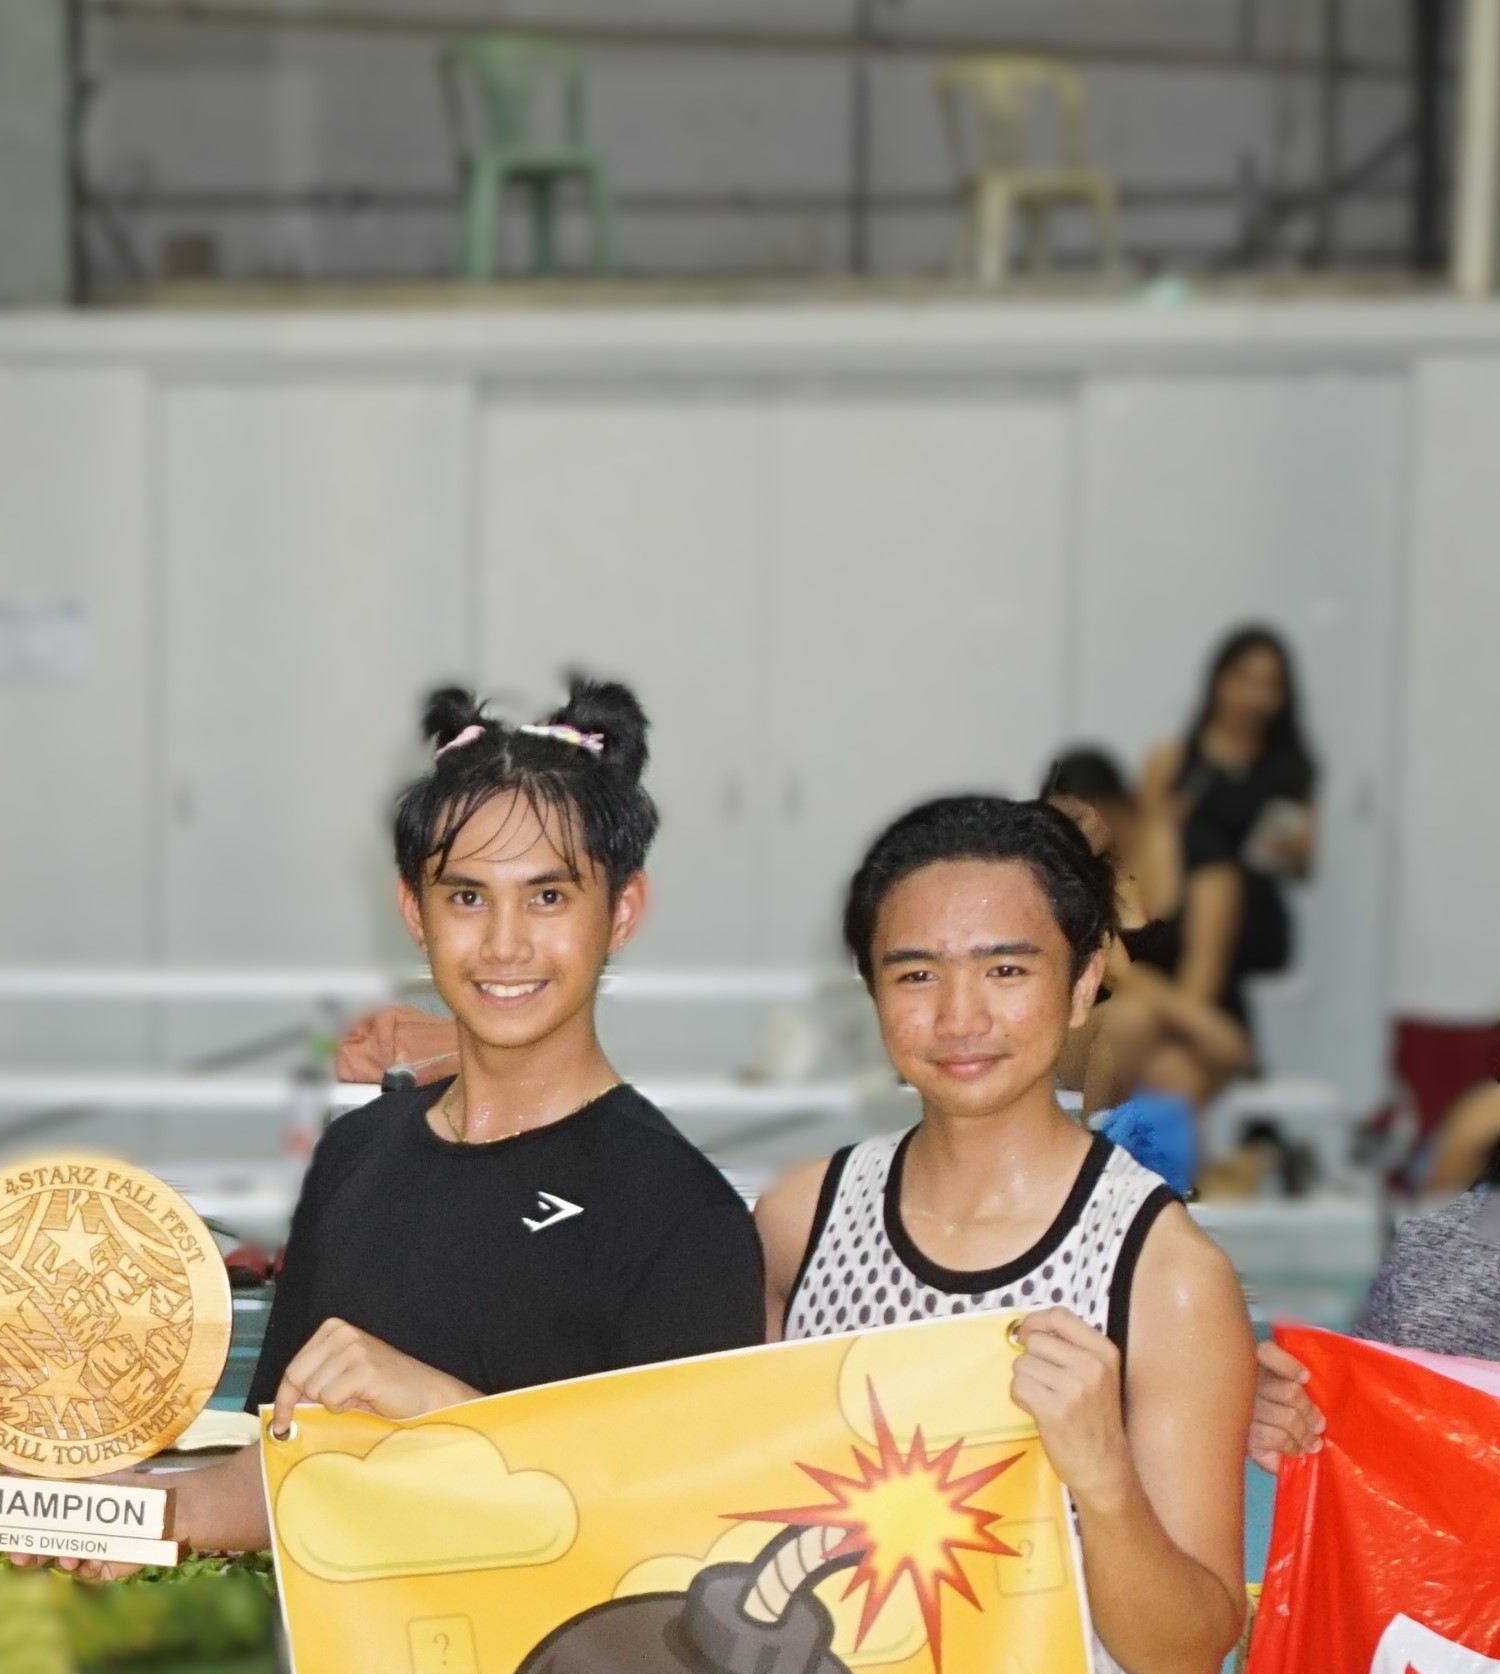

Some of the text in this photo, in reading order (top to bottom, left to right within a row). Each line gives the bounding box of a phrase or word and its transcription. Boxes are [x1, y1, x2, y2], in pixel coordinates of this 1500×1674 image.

[104, 1172, 159, 1211] FALL
[158, 1208, 207, 1265] FEST
[52, 1383, 187, 1465] TOURNAMENT
[40, 1536, 108, 1554] DIVISION
